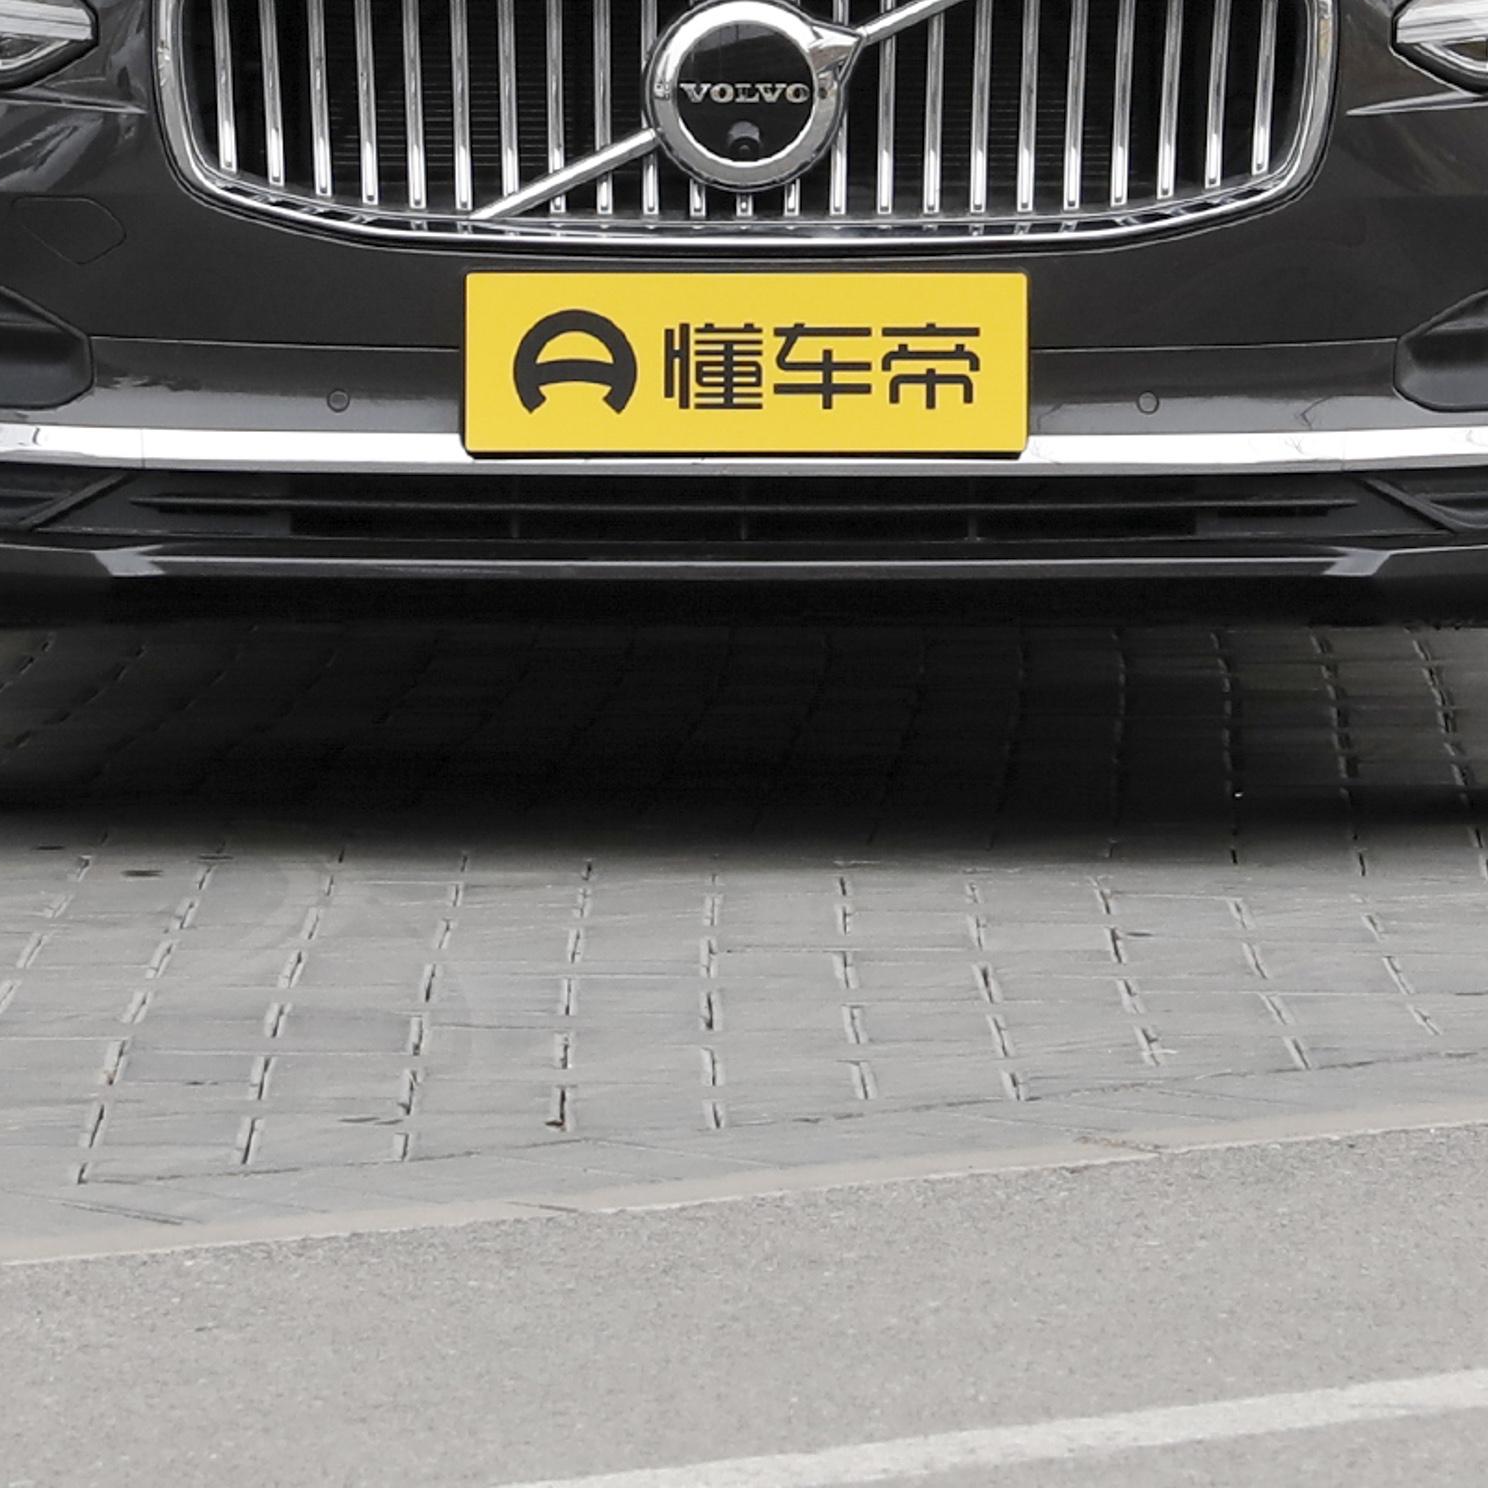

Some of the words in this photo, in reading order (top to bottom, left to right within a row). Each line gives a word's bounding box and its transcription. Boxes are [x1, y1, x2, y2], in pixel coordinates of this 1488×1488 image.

[679, 82, 811, 104] VOLVO
[663, 323, 980, 411] 懂车帝
